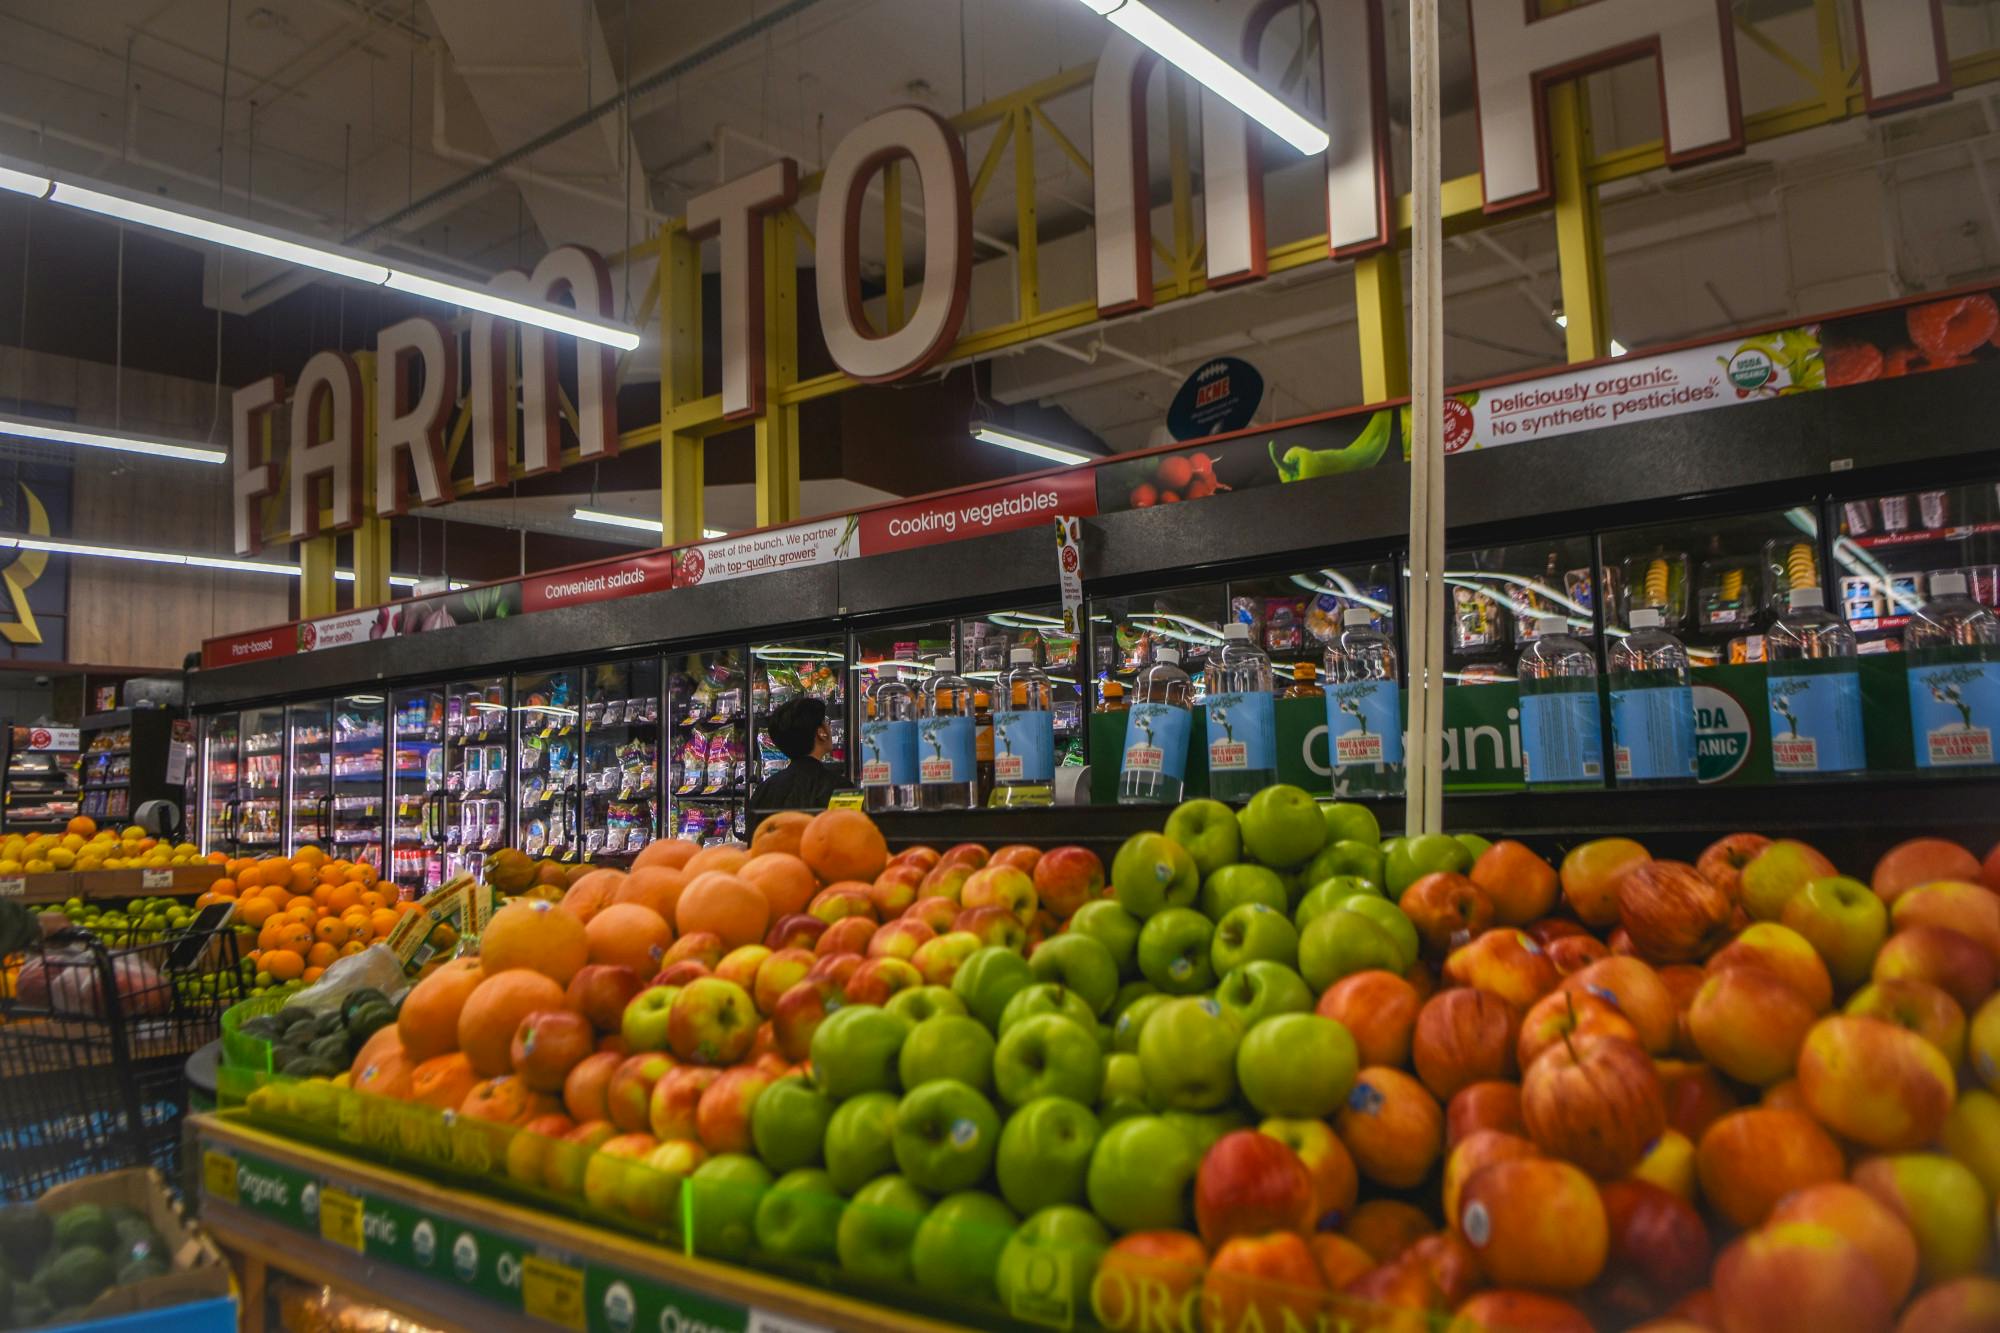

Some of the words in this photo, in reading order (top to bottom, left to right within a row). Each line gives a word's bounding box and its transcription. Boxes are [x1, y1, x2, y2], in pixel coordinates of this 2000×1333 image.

[232, 244, 619, 556] FARM
[687, 105, 973, 421] TO
[1737, 356, 1763, 369] USDA
[1490, 382, 1589, 414] Deliciously
[1596, 364, 1679, 395] organic.
[1492, 421, 1517, 437] No
[1522, 404, 1606, 435] synthetic
[1612, 384, 1720, 421] pesticides.
[889, 510, 956, 533] Cooking
[960, 491, 1058, 526] vegetables
[708, 549, 726, 559] Best
[728, 544, 736, 555] of
[738, 543, 752, 554] the
[753, 537, 784, 551] bunch.
[786, 534, 801, 545] We
[803, 527, 838, 545] partner
[708, 564, 726, 575] with
[728, 554, 778, 573] top-quality
[780, 548, 816, 566] growers
[545, 578, 606, 599] Convenient
[608, 568, 645, 589] salads
[231, 637, 273, 656] Plant-based
[1692, 708, 1728, 729] DA
[1697, 738, 1738, 757] ANIC
[237, 1164, 289, 1206] Organic
